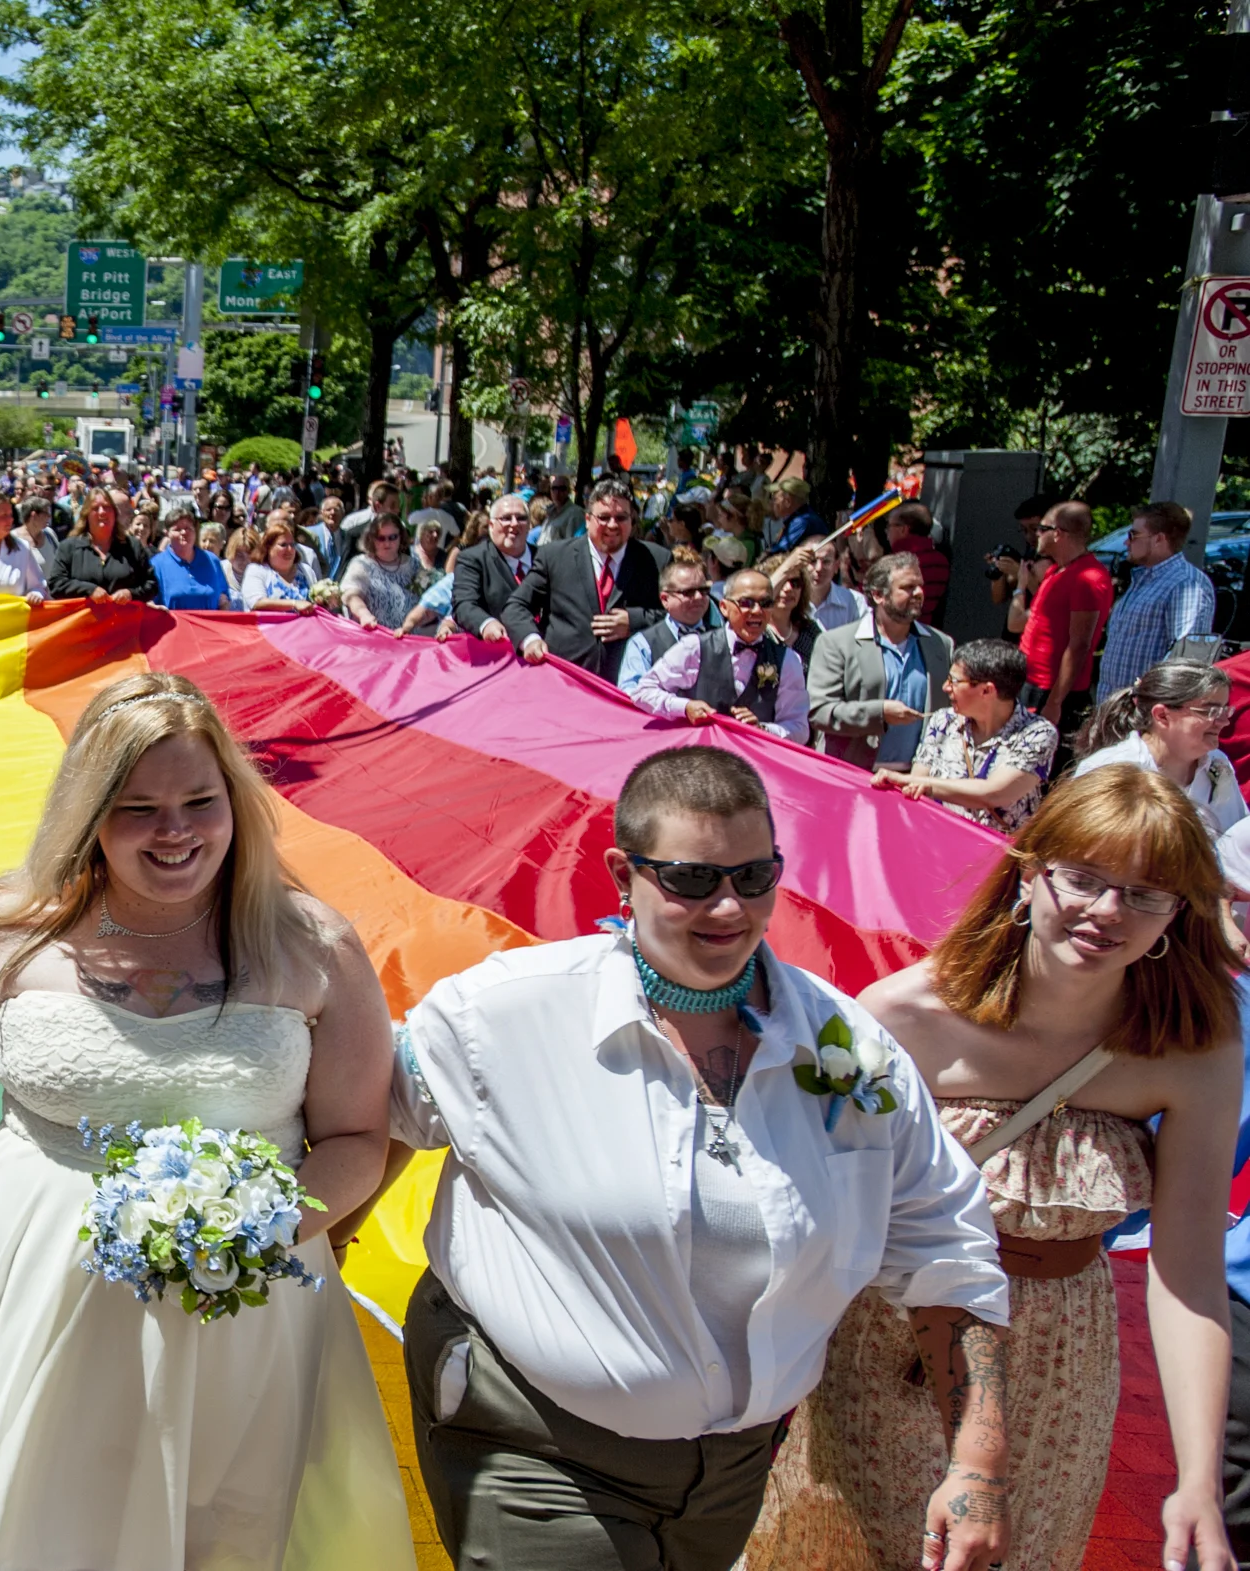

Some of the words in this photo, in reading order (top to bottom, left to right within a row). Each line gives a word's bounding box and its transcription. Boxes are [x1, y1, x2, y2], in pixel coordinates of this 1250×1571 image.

[106, 247, 135, 258] WEST
[82, 271, 96, 284] Ft
[103, 271, 130, 284] Pitt
[267, 268, 297, 280] EAST
[80, 288, 131, 303] Bridge
[105, 334, 123, 342] Blvd
[137, 334, 148, 342] the
[1219, 345, 1237, 358] OR
[1196, 380, 1210, 392] IN
[1217, 380, 1247, 392] THIS
[1194, 395, 1245, 408] STREET
